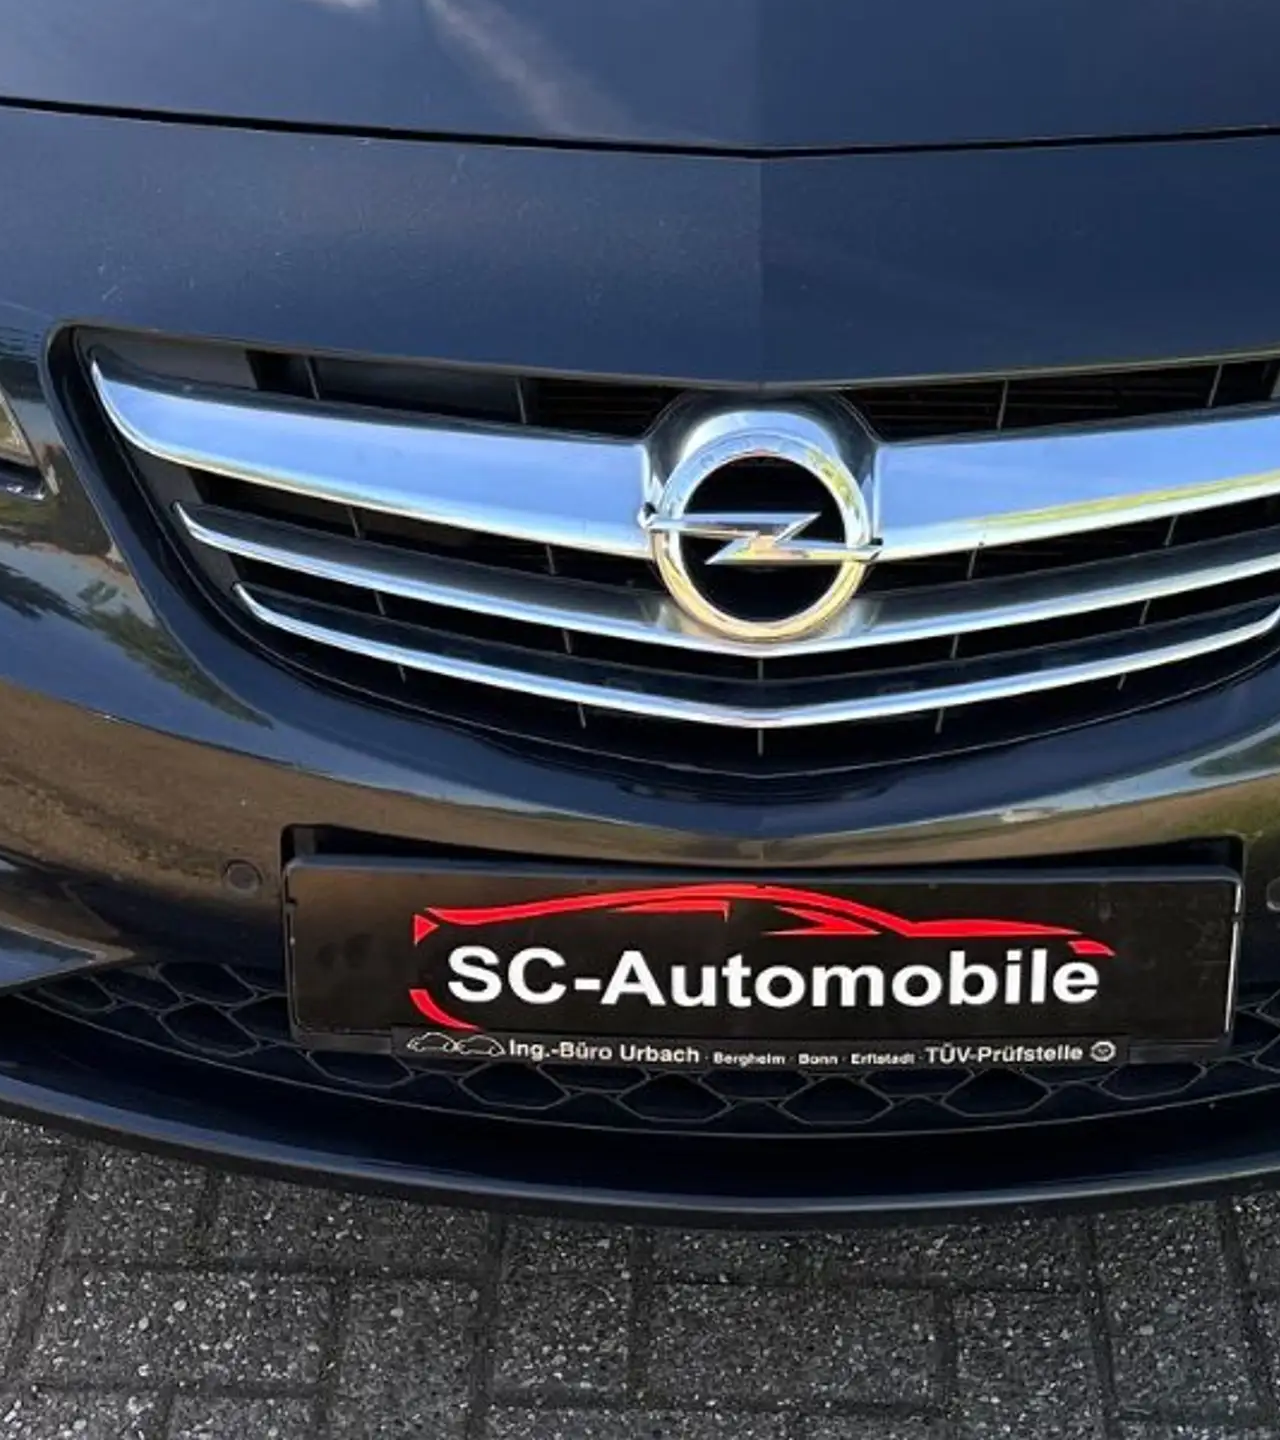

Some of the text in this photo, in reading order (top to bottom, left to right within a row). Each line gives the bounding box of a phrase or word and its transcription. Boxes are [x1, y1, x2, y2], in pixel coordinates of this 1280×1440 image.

[446, 946, 1100, 1008] SC-Automobile
[509, 1039, 613, 1061] Ing.-Büro
[620, 1043, 700, 1063] Urbach
[713, 1050, 786, 1068] Bergheim
[798, 1052, 838, 1065] Bonn
[924, 1041, 1084, 1064] TÜV-Prüfstelle
